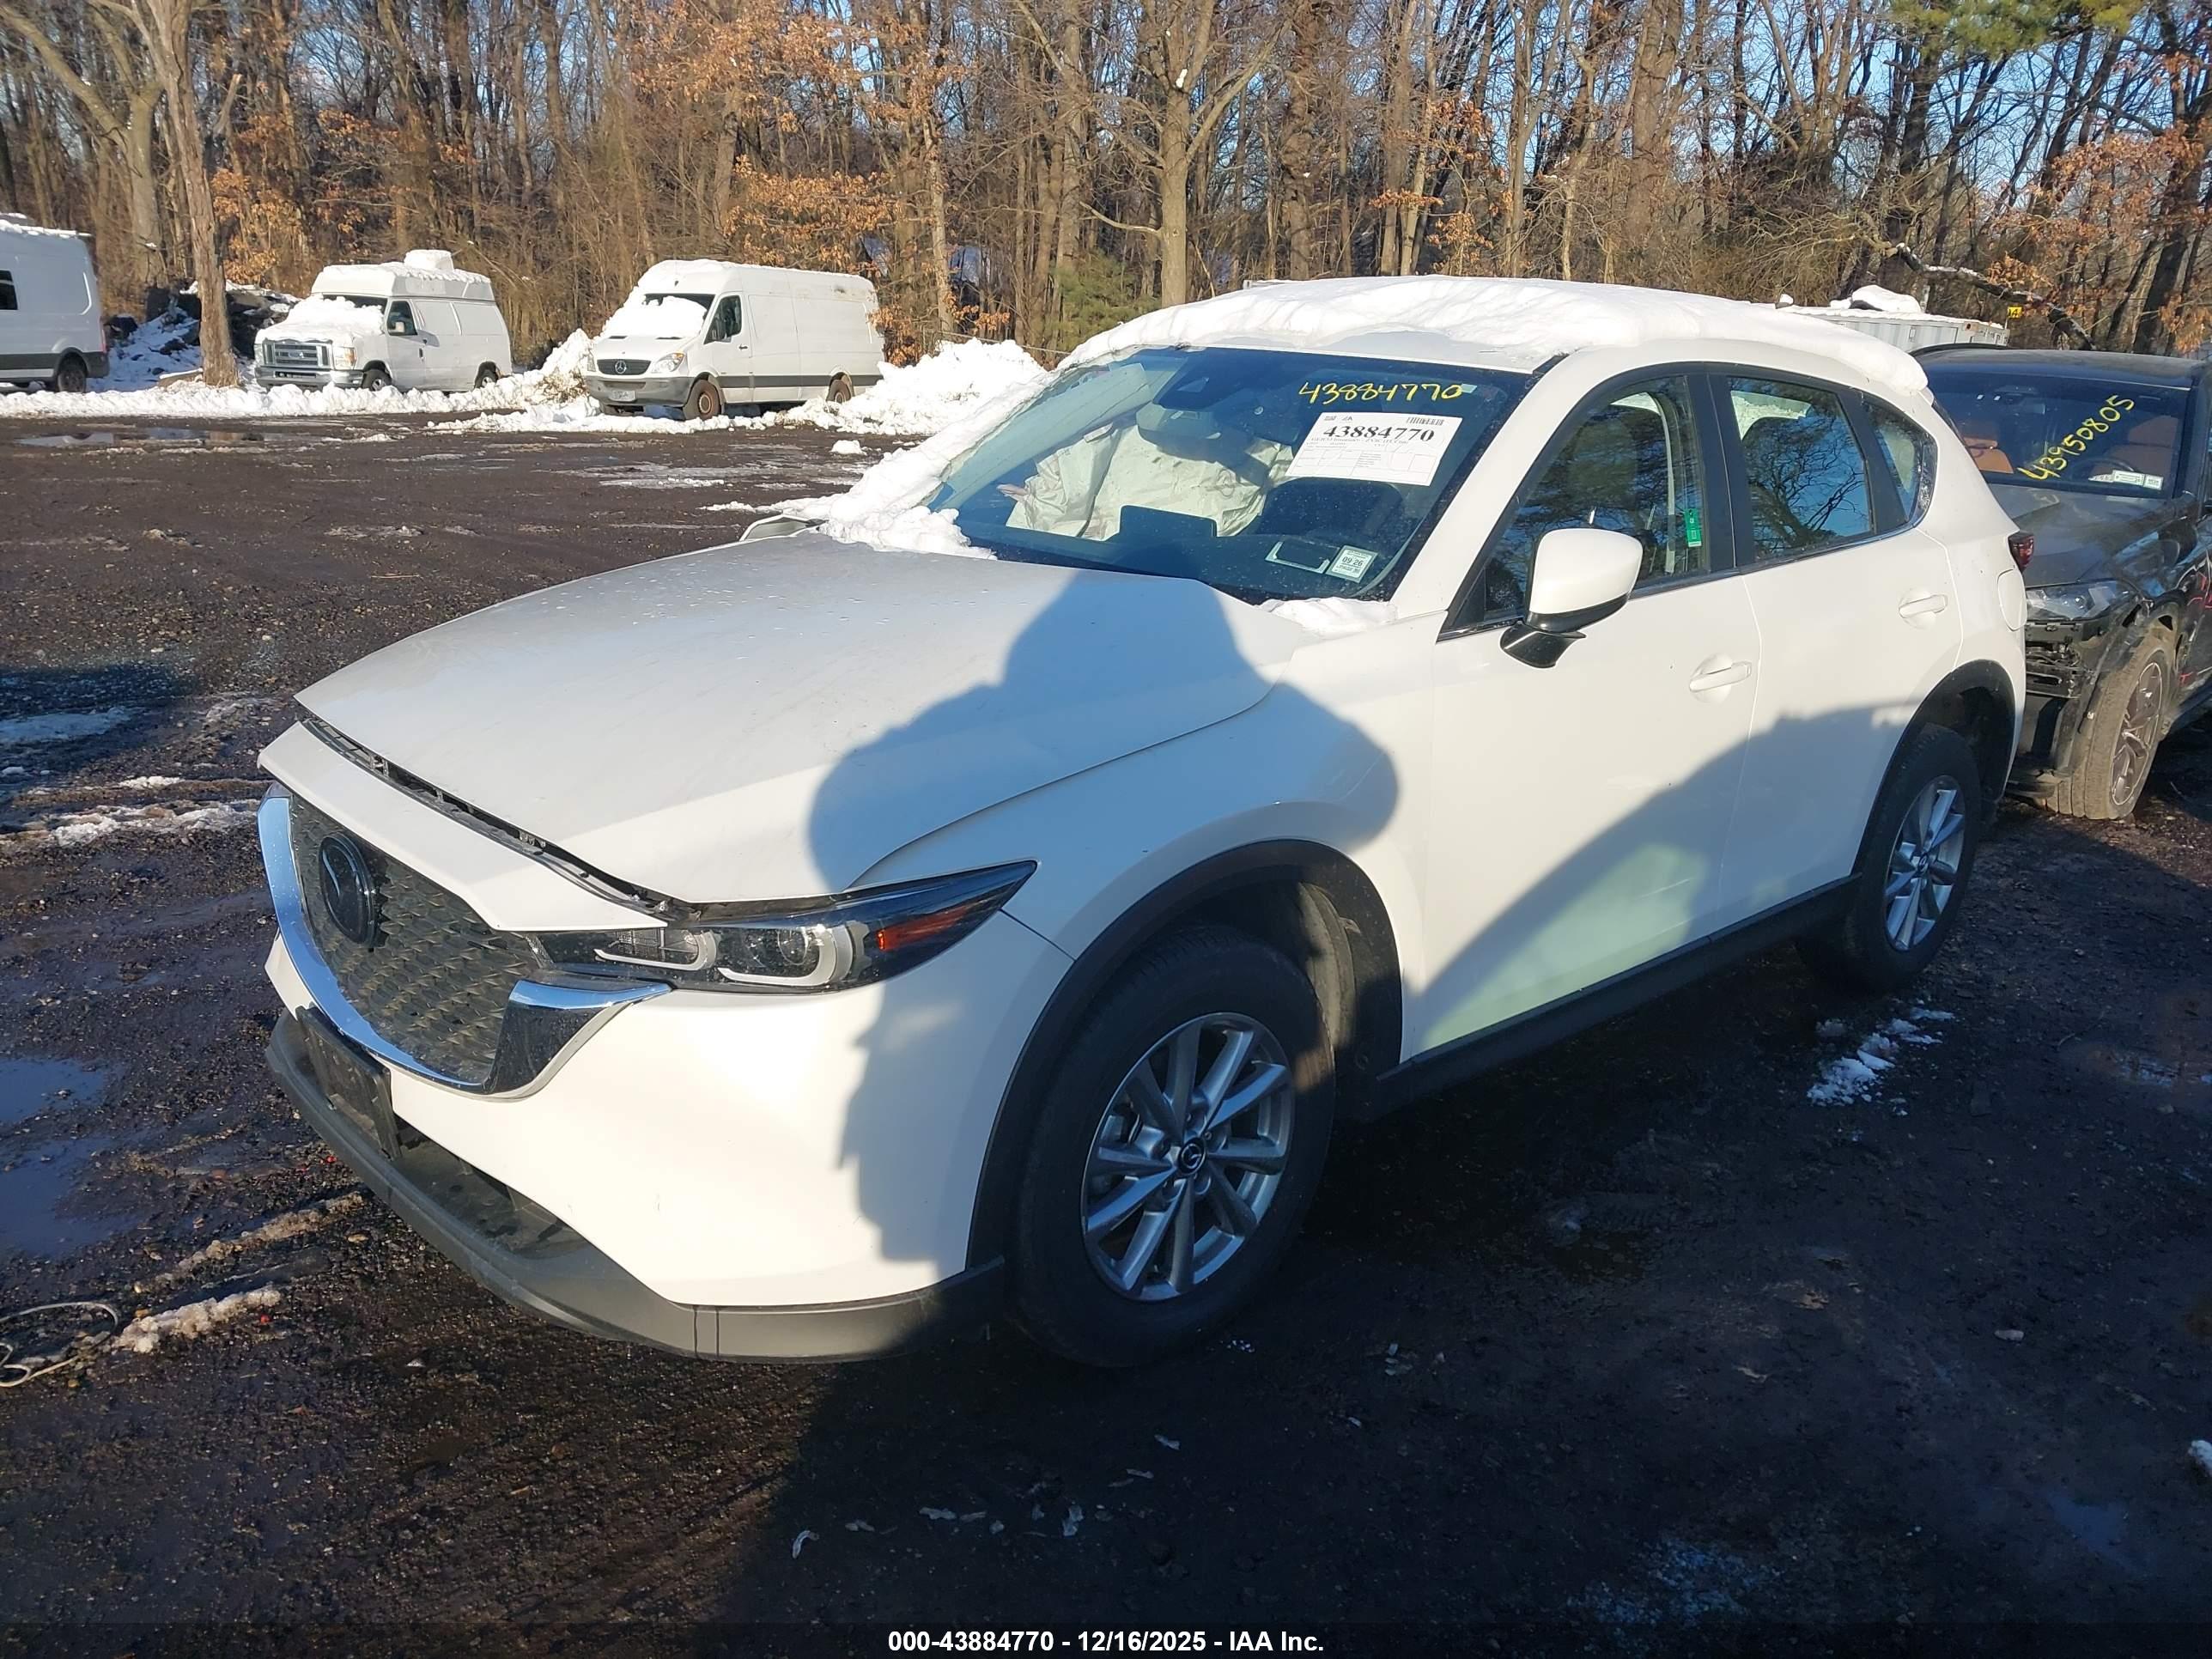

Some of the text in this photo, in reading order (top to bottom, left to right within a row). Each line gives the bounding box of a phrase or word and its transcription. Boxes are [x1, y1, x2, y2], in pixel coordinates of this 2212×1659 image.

[1298, 382, 1462, 404] 43884770
[1322, 424, 1436, 442] 43884770
[2017, 394, 2135, 480] 43950805
